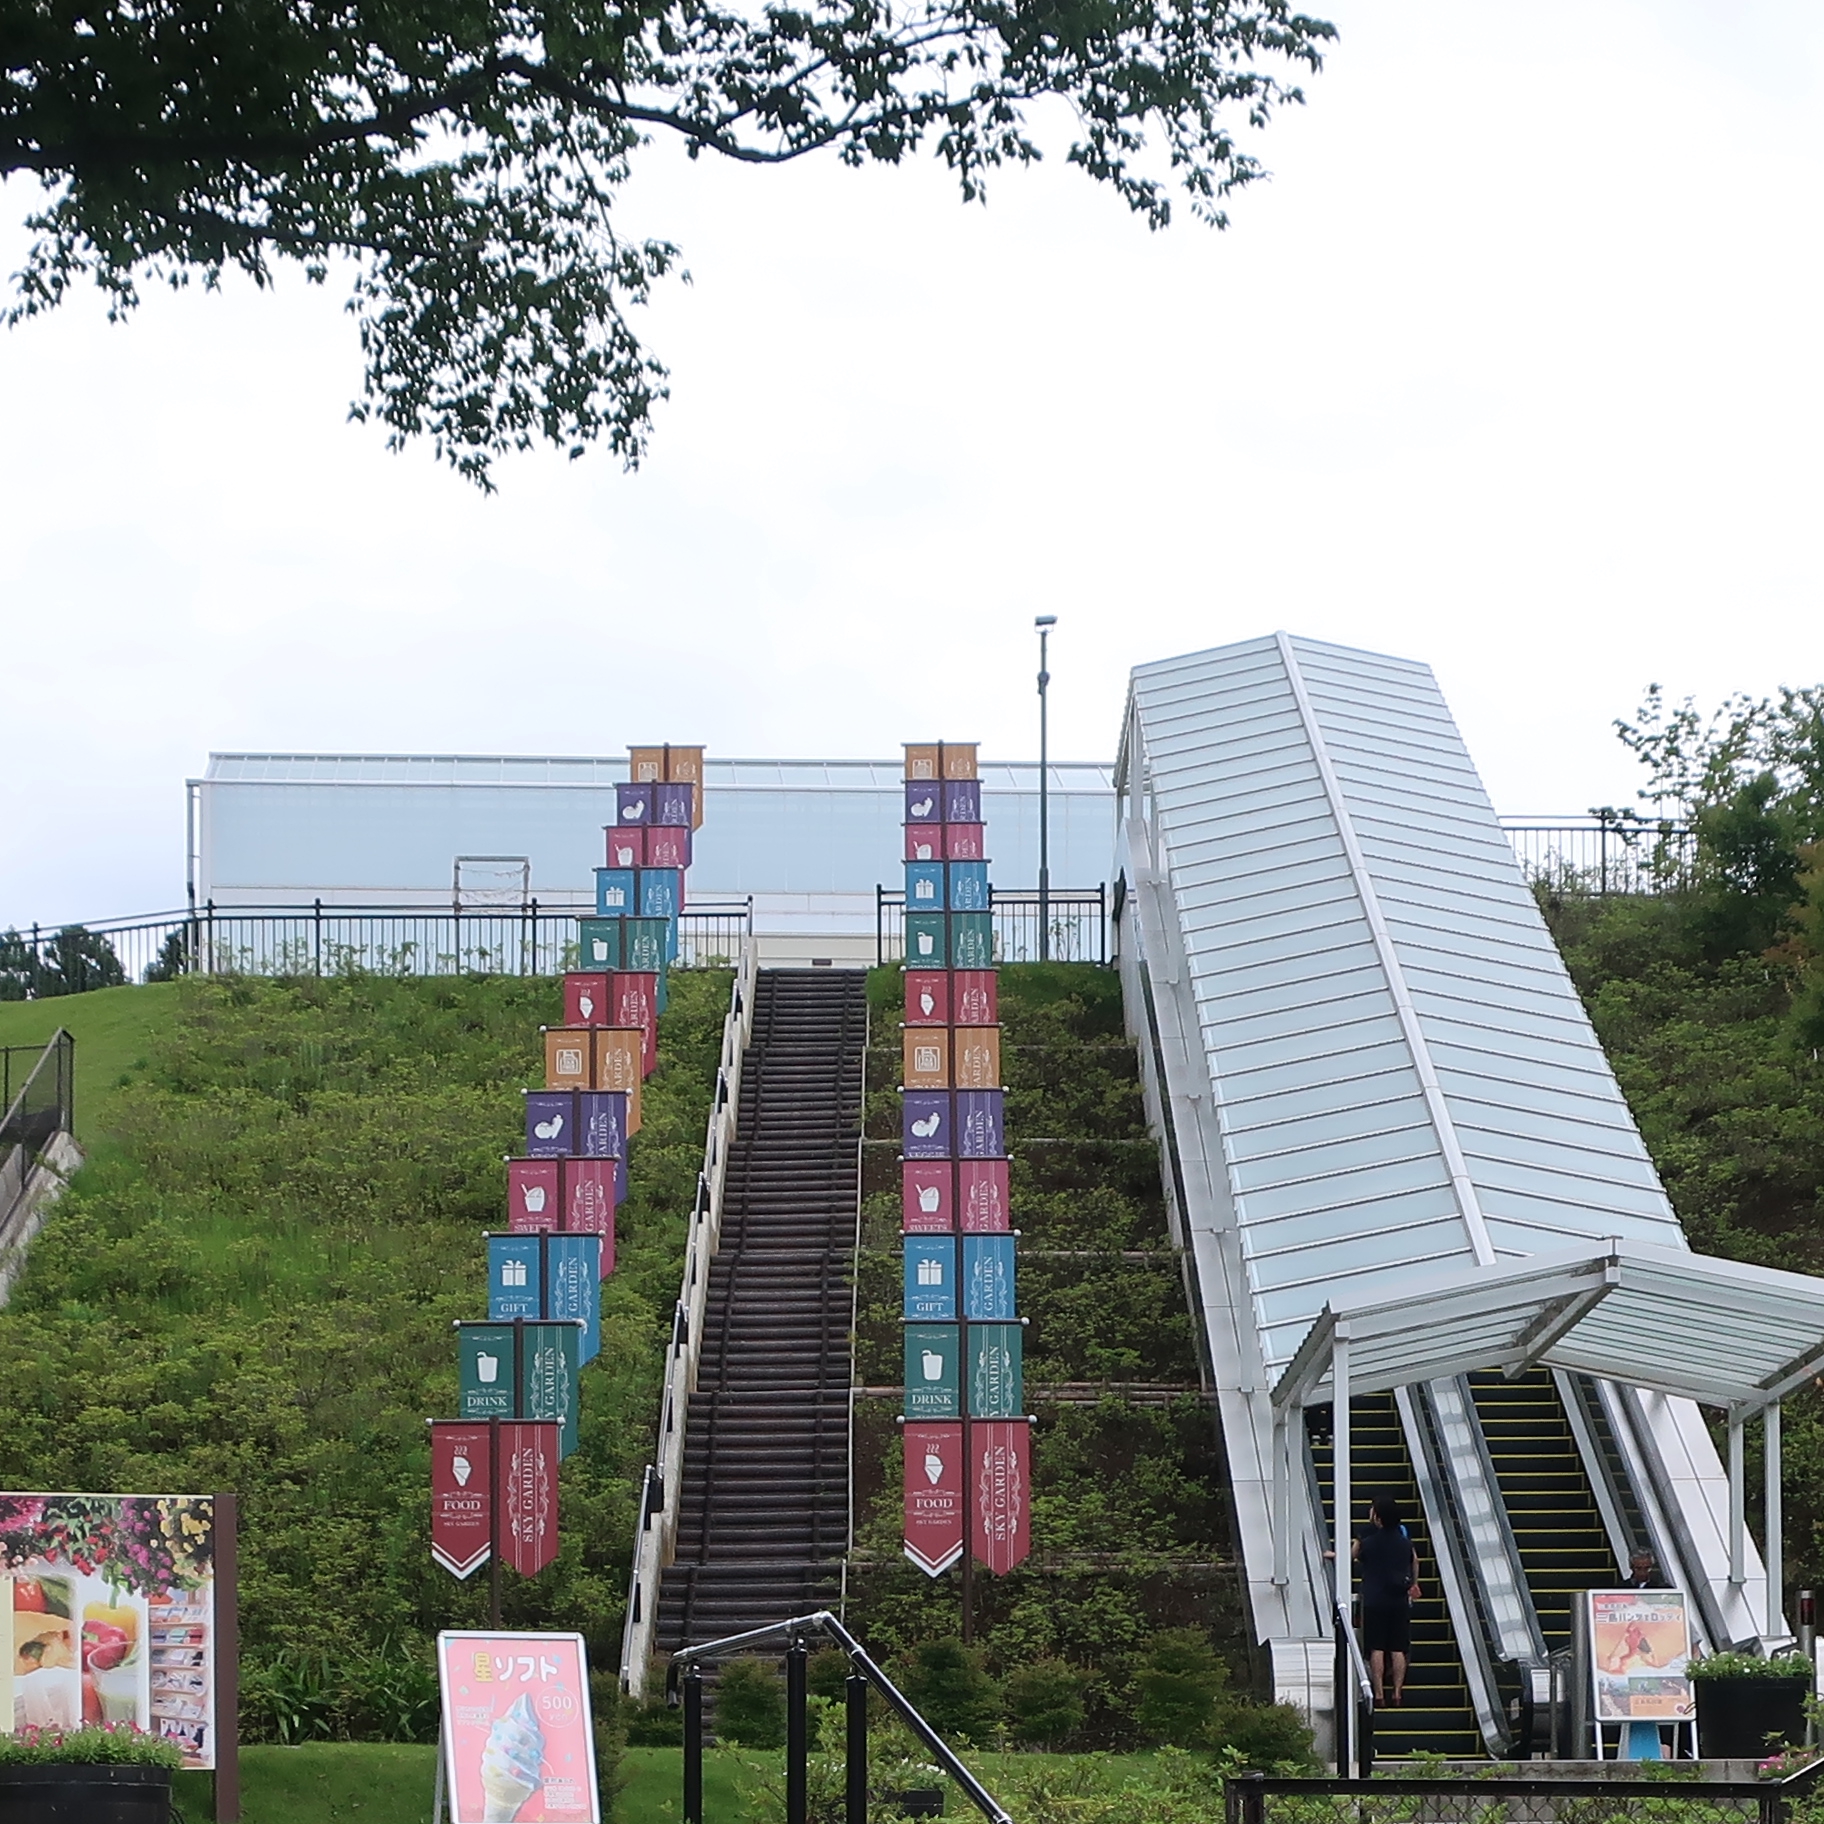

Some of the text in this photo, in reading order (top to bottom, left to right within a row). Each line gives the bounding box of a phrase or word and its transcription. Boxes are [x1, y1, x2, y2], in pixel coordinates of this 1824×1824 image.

[568, 1257, 578, 1312] GARDEN
[983, 1256, 993, 1311] GARDEN
[500, 1303, 528, 1313] GIFT
[916, 1302, 944, 1312] GIFT
[544, 1346, 555, 1406] GARDEN
[989, 1345, 1000, 1405] GARDEN
[467, 1396, 508, 1407] DRINK
[911, 1394, 952, 1405] DRINK
[522, 1447, 534, 1543] SKY GARDEN
[916, 1498, 953, 1508] FOOD
[994, 1445, 1006, 1541] SKY GARDEN
[443, 1500, 481, 1510] FOOD
[474, 1652, 558, 1683] 星ソフト
[542, 1696, 572, 1710] 500
